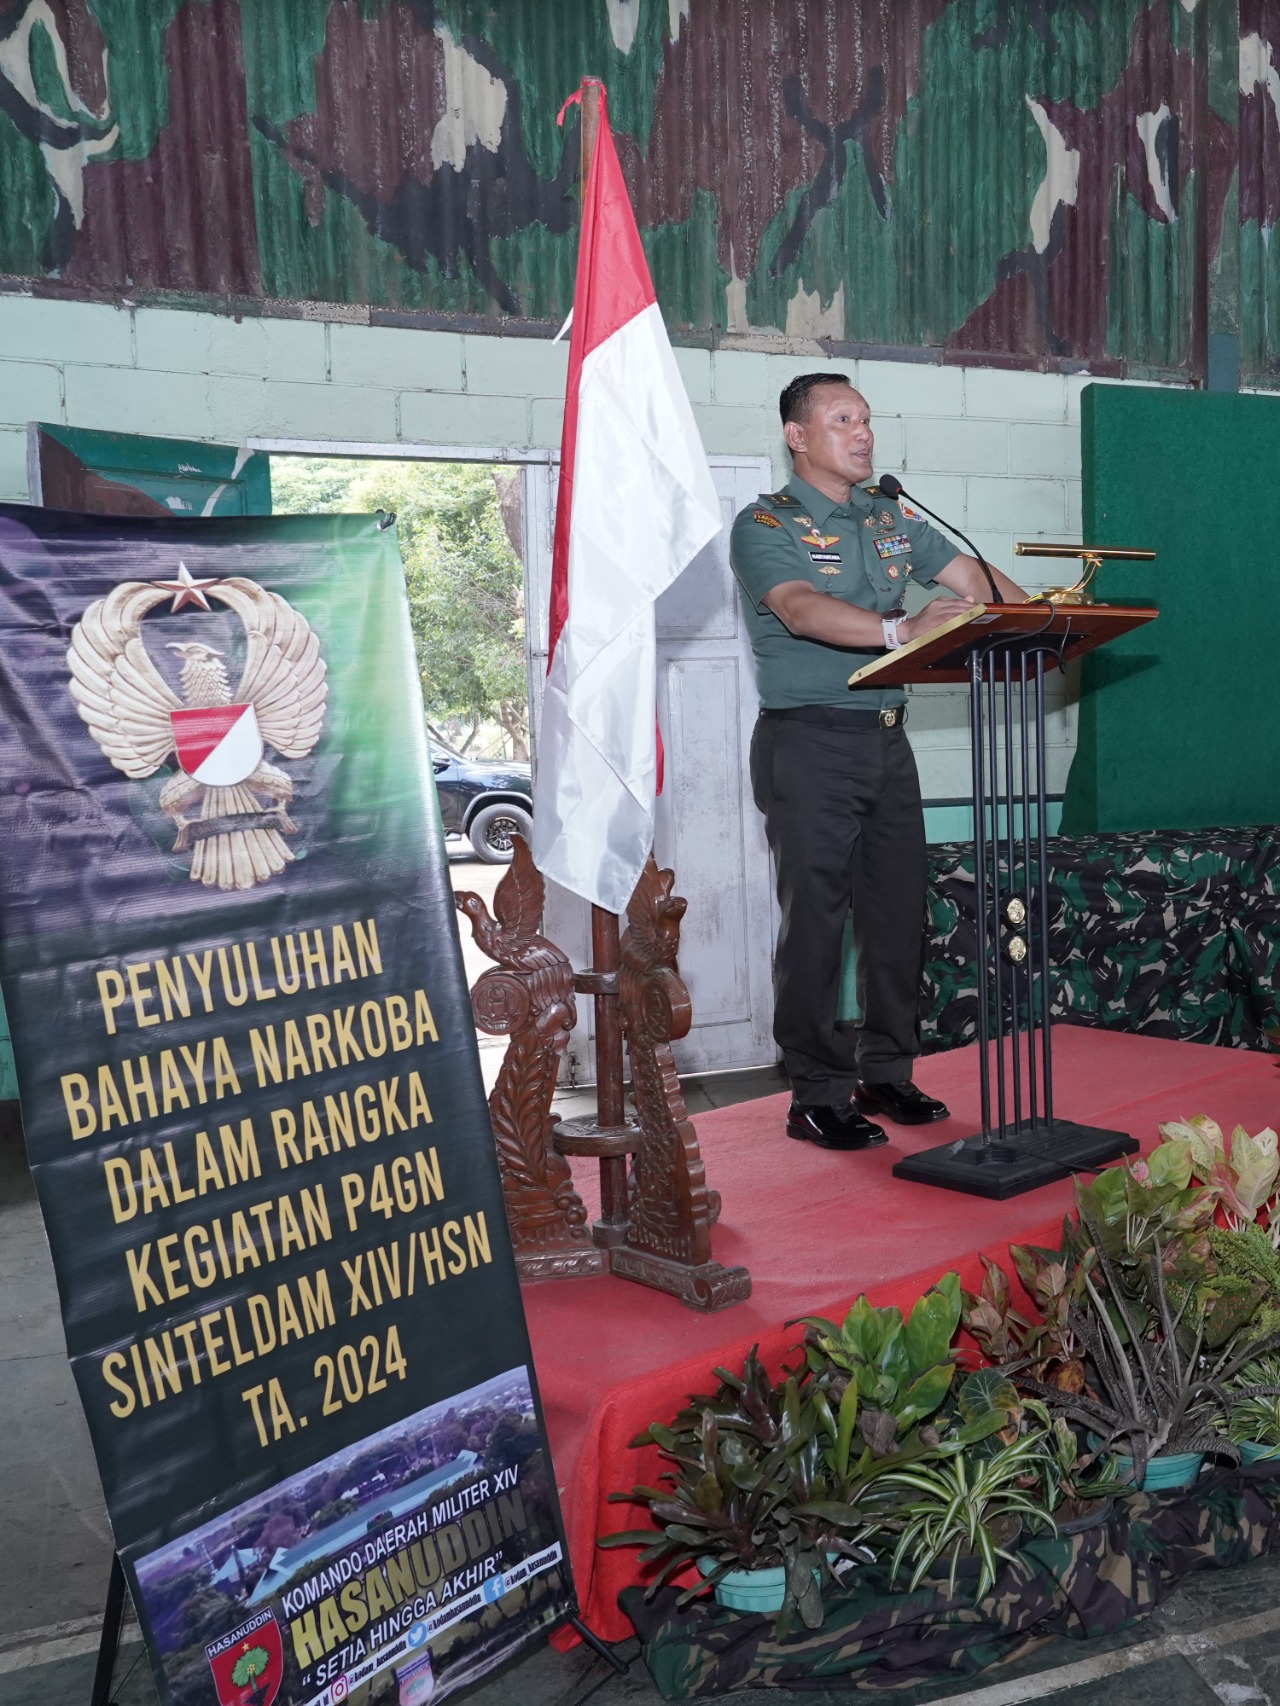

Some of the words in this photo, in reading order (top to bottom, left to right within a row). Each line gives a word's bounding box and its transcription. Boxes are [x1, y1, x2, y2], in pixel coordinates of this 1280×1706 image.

[96, 918, 384, 1035] PENYULUHAN
[60, 1036, 242, 1140] BAHAYA
[249, 989, 440, 1088] NARKOBA
[103, 1119, 262, 1224] DALAM
[271, 1071, 434, 1169] RANGKA
[125, 1184, 333, 1313] KEGIATAN
[341, 1146, 445, 1232] P4GN
[102, 1268, 336, 1419] SINTELDAM
[341, 1211, 493, 1317] XIV/HSN
[242, 1377, 309, 1448] TA.
[313, 1324, 408, 1417] 2024
[281, 1560, 362, 1619] KOMANDO
[364, 1512, 428, 1564] DAERAH
[432, 1479, 490, 1528] MILITER
[494, 1464, 519, 1498] XIV
[290, 1486, 528, 1670] HASANUDDIN
[207, 1609, 272, 1657] HASANUDDIN
[370, 1592, 437, 1650] HINGGA
